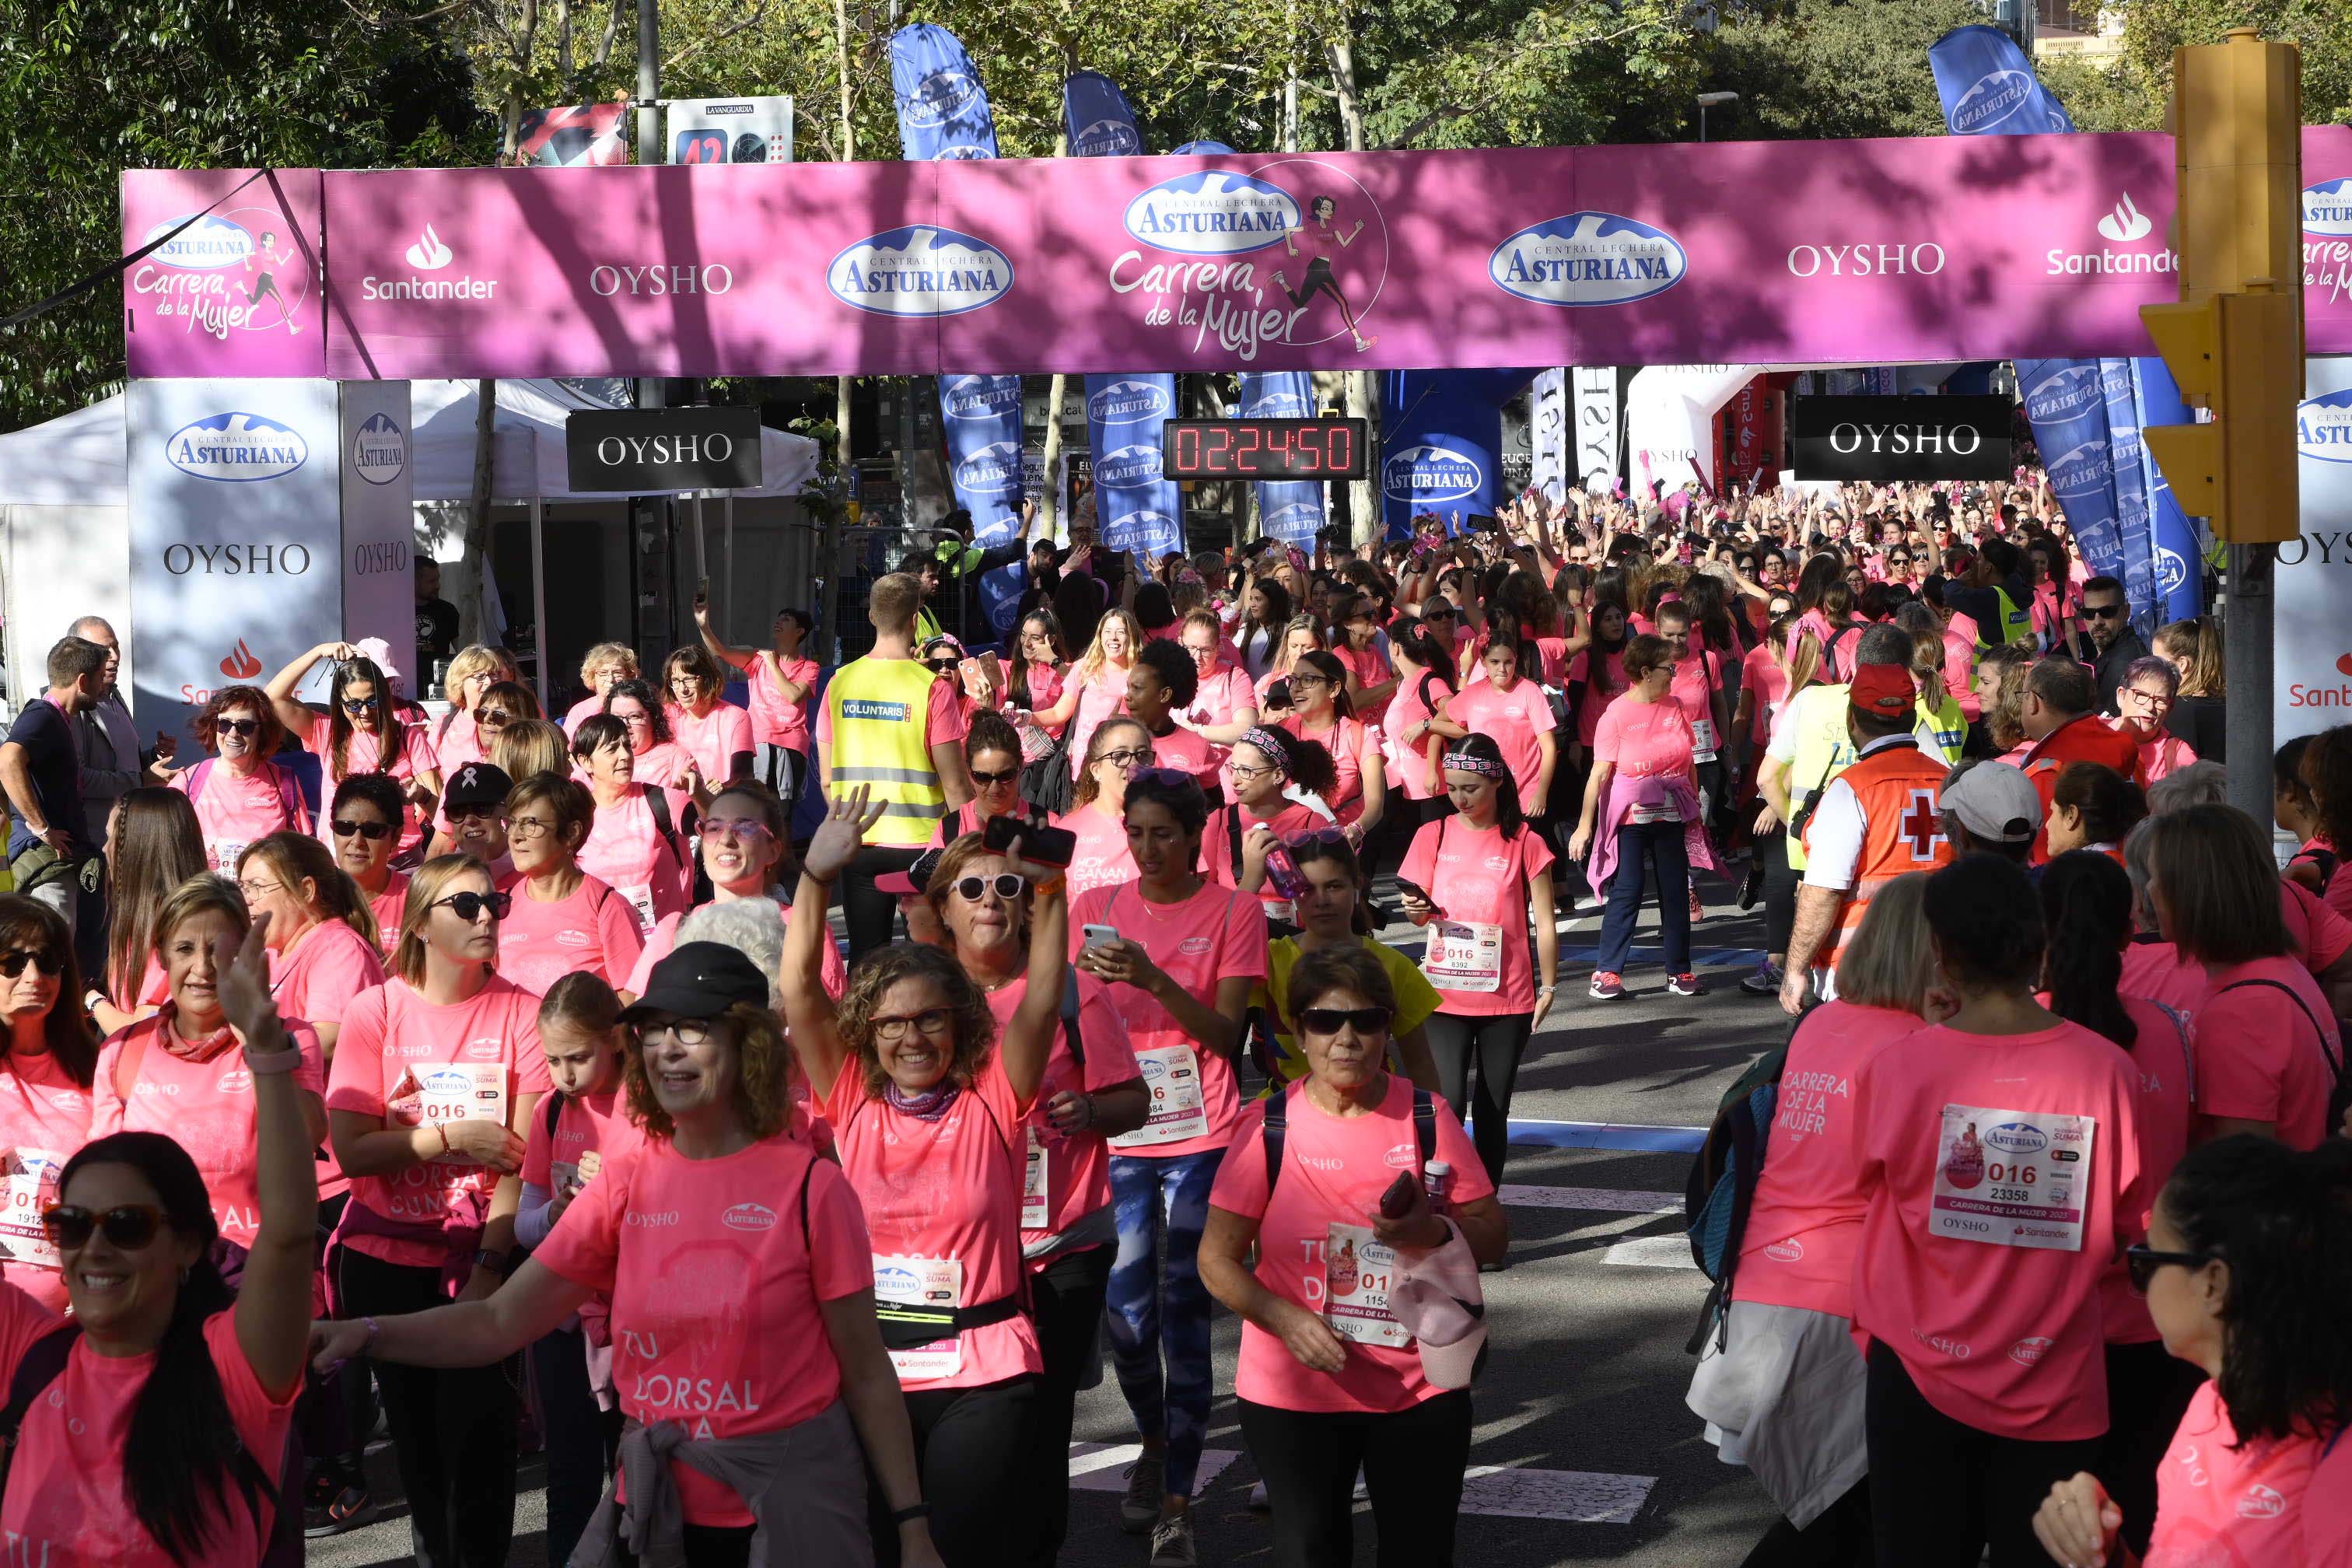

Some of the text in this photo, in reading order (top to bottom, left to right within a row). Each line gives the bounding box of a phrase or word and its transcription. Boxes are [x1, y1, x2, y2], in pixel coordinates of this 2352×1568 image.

[1226, 198, 1283, 208] LECHERA
[1138, 203, 1288, 233] ASTURIANA
[1535, 243, 1666, 254] CENTRAL LECHERA
[870, 255, 928, 266] CENTRAL
[1504, 248, 1672, 283] ASTURIANA
[1787, 243, 1945, 277] OYSHO
[2046, 248, 2179, 276] Santande
[134, 265, 224, 295] Carrera
[590, 264, 733, 296] OYSHO
[841, 260, 1002, 292] ASTURIANA
[1109, 250, 1255, 294] Carrera
[2319, 264, 2333, 285] la
[362, 275, 497, 300] Santander
[156, 292, 259, 340] de la Mujer
[1145, 289, 1309, 362] de la Mujer
[1829, 422, 1980, 454] OYSHO
[177, 438, 299, 464] ASTURIANA
[357, 440, 402, 467] ASTURIANA
[597, 433, 733, 465] OYSHO
[1177, 427, 1350, 471] 02:24:50
[1640, 449, 1697, 462] YSHO
[1386, 469, 1474, 489] ASTURIANA
[163, 544, 310, 575] OYSHO
[355, 541, 406, 576] OYSHO
[843, 703, 903, 718] VOLUNTARIS
[1634, 761, 1652, 772] TU
[1076, 856, 1106, 869] HOY
[1074, 867, 1127, 881] GANAN
[1448, 949, 1473, 959] 016
[1168, 1057, 1188, 1066] SUMA
[1783, 1070, 1849, 1099] CARRERA
[427, 1104, 465, 1118] 016
[1786, 1090, 1825, 1113] DE LA
[1158, 1113, 1179, 1122] MUJER
[1779, 1111, 1825, 1136] MUJER
[554, 1129, 584, 1143] YSHO
[1167, 1122, 1199, 1135] Santander
[2053, 1132, 2080, 1142] SUMA
[1990, 1132, 2042, 1147] ASTURIANA
[1989, 1163, 2036, 1185] 016
[1990, 1188, 2028, 1202] 23358
[627, 1210, 679, 1228] OYSHO
[726, 1213, 773, 1226] ASTURIANA
[1949, 1200, 2068, 1219] CARRERA DE LA MUJER 2023
[1943, 1217, 1990, 1233] OYSHO
[2025, 1227, 2070, 1239] Santander
[876, 1280, 916, 1289] STURIANA
[1362, 1273, 1388, 1291] 01
[621, 1329, 658, 1360] TU
[633, 1374, 760, 1411] DORSAL
